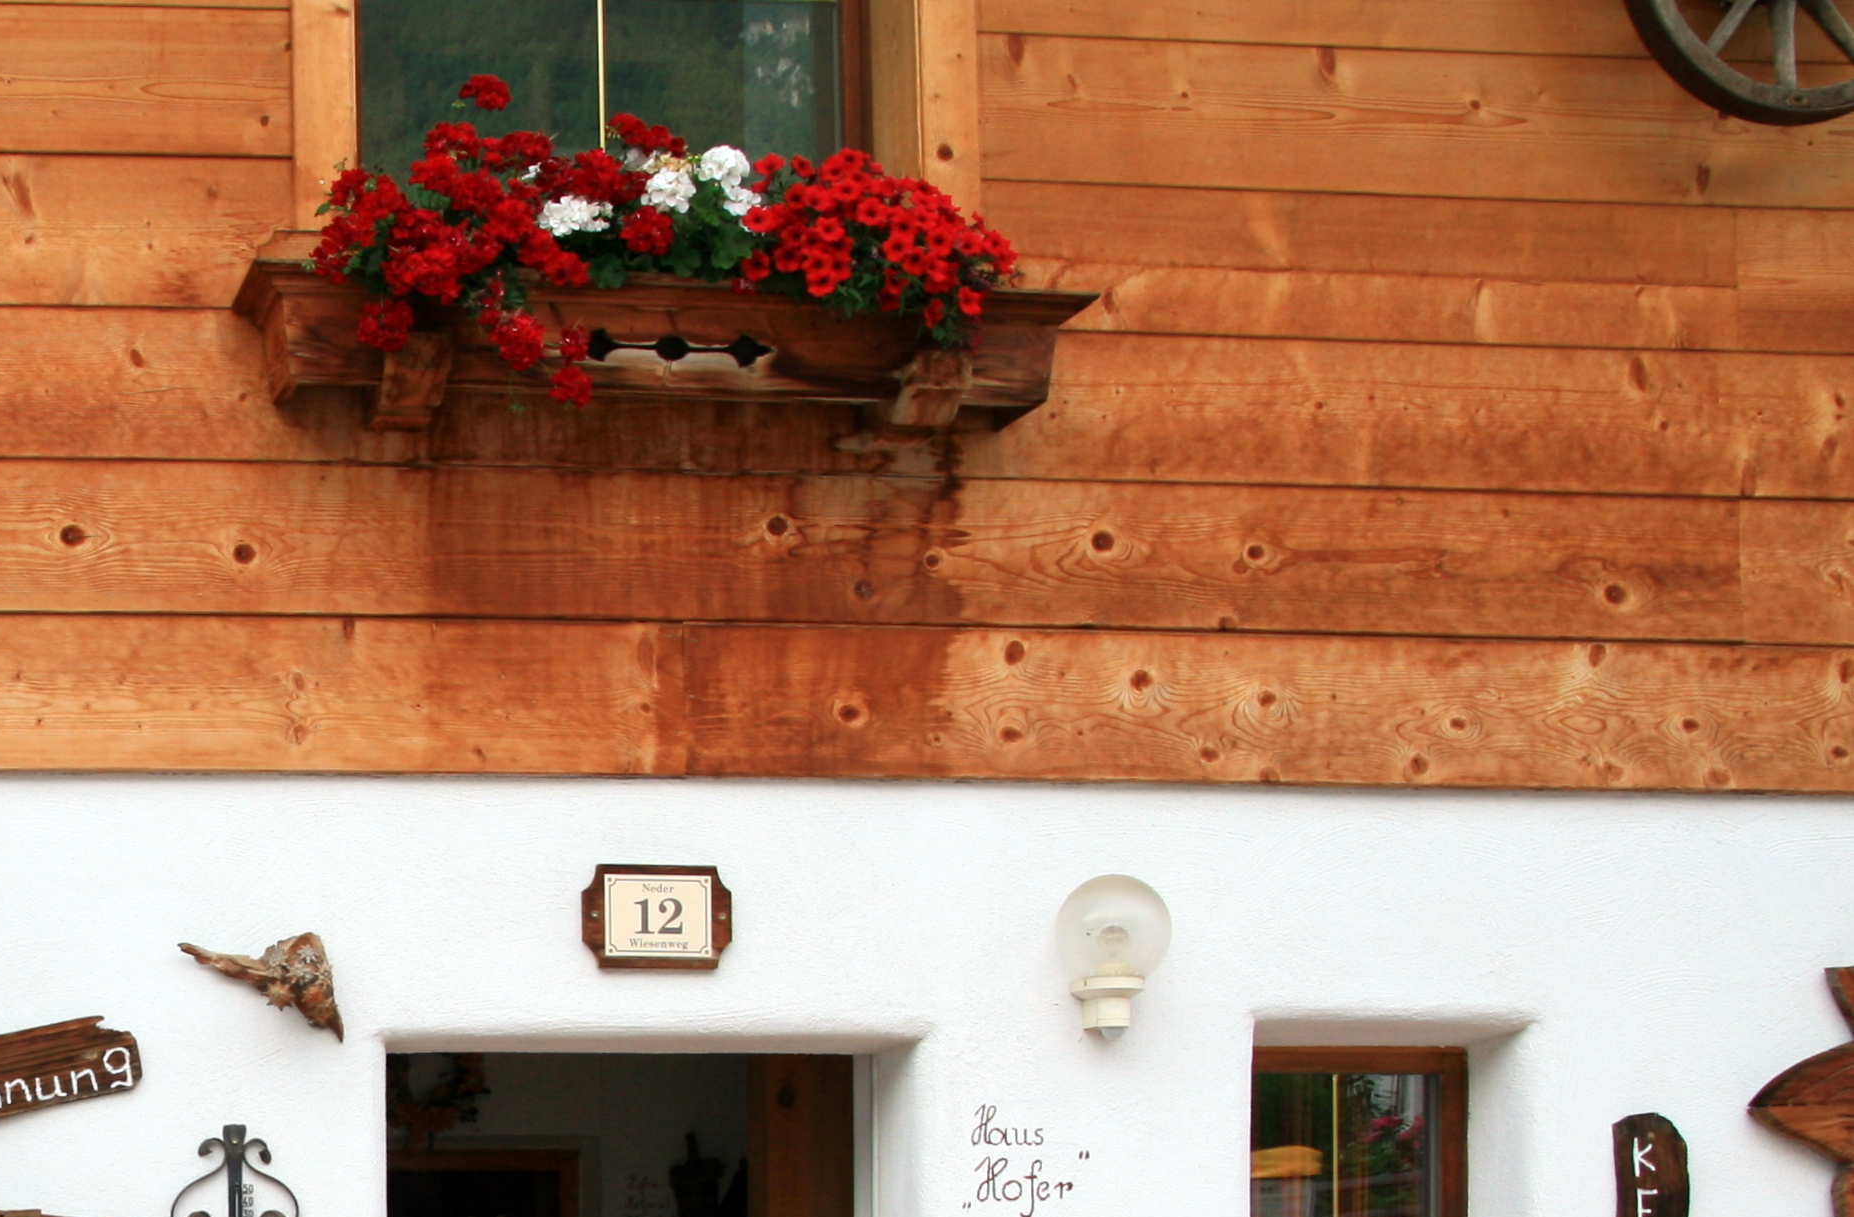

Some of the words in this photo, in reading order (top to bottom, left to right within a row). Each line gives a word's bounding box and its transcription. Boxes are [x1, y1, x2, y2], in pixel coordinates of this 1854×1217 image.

[642, 883, 674, 893] Neder
[633, 897, 683, 935] 12
[628, 938, 689, 950] Wiesenweg
[971, 1104, 1044, 1146] Haus
[242, 1183, 254, 1195] 50
